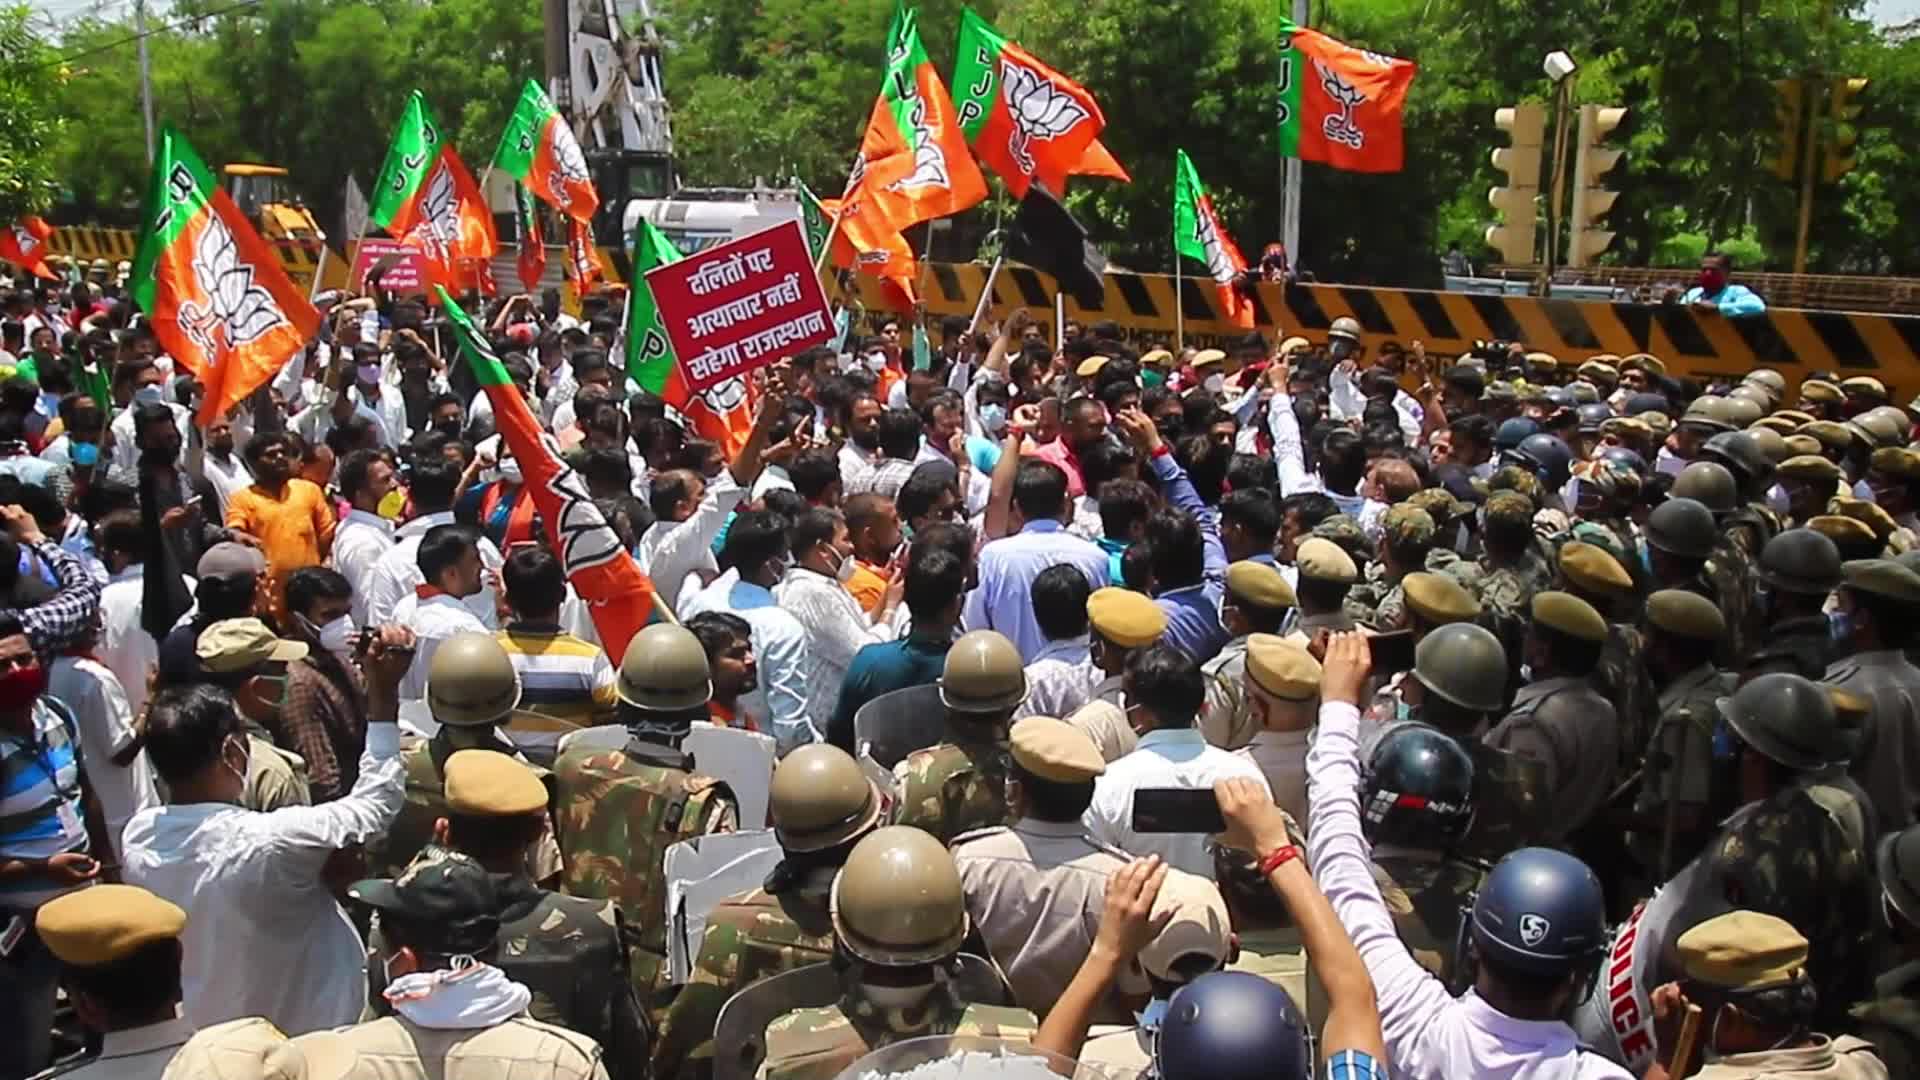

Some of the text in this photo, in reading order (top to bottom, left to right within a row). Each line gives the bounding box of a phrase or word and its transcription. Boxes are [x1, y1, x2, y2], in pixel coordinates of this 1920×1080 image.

[687, 247, 775, 296] दलितों पर
[687, 272, 802, 339] अत्याचार नहीं
[687, 343, 742, 380] सहेगा
[740, 310, 827, 359] राजस्थान
